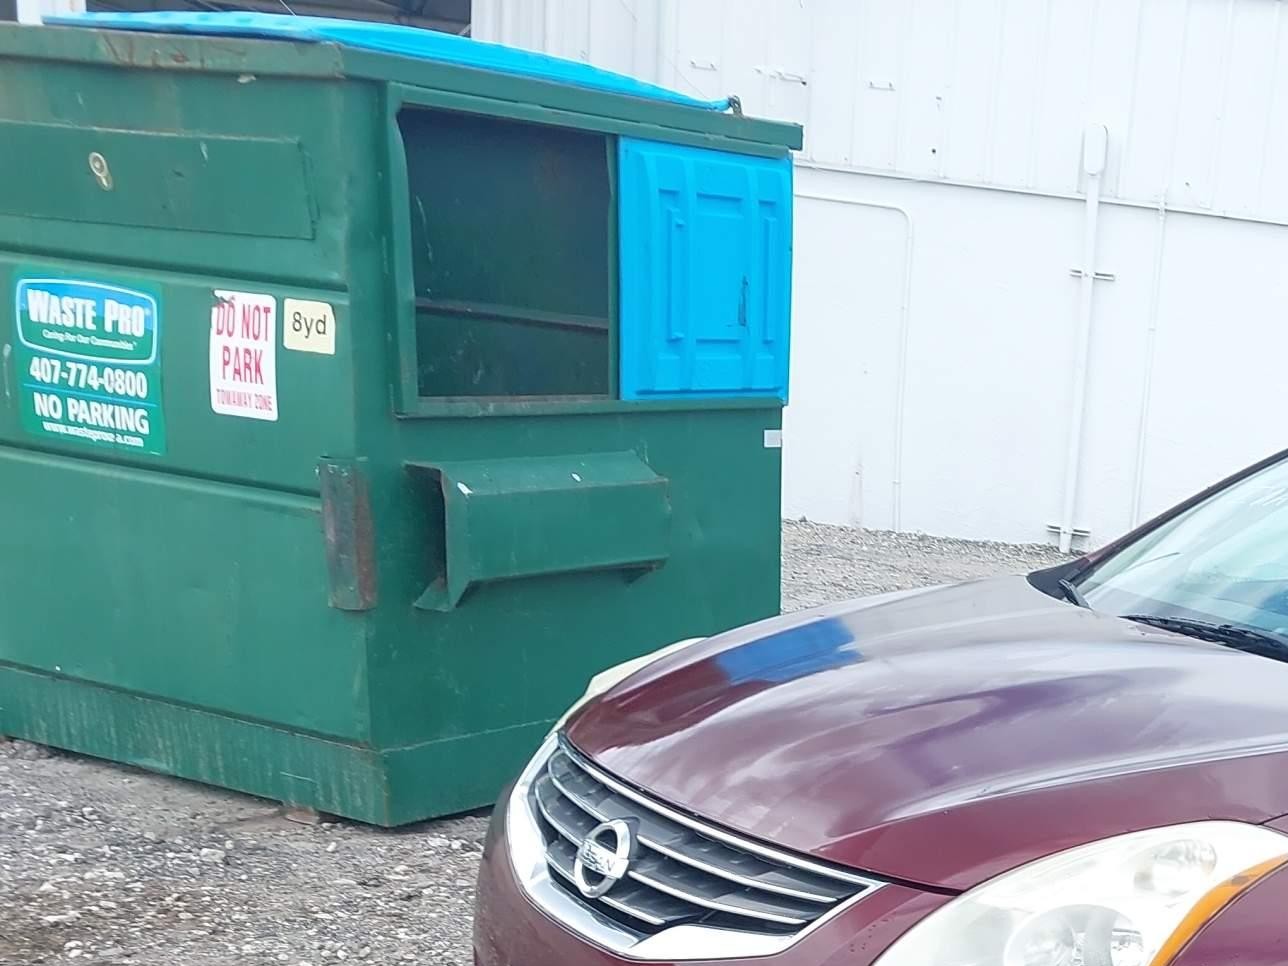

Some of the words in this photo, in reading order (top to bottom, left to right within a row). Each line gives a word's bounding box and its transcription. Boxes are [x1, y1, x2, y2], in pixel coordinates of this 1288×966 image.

[27, 288, 97, 331] WASTE
[104, 298, 145, 338] PRO
[216, 302, 236, 338] DO
[241, 303, 271, 342] NOT
[292, 311, 328, 339] 8yd
[29, 356, 148, 399] 407-774-0800
[222, 345, 264, 385] PARK
[33, 391, 63, 420] NO
[66, 397, 150, 435] PARKING
